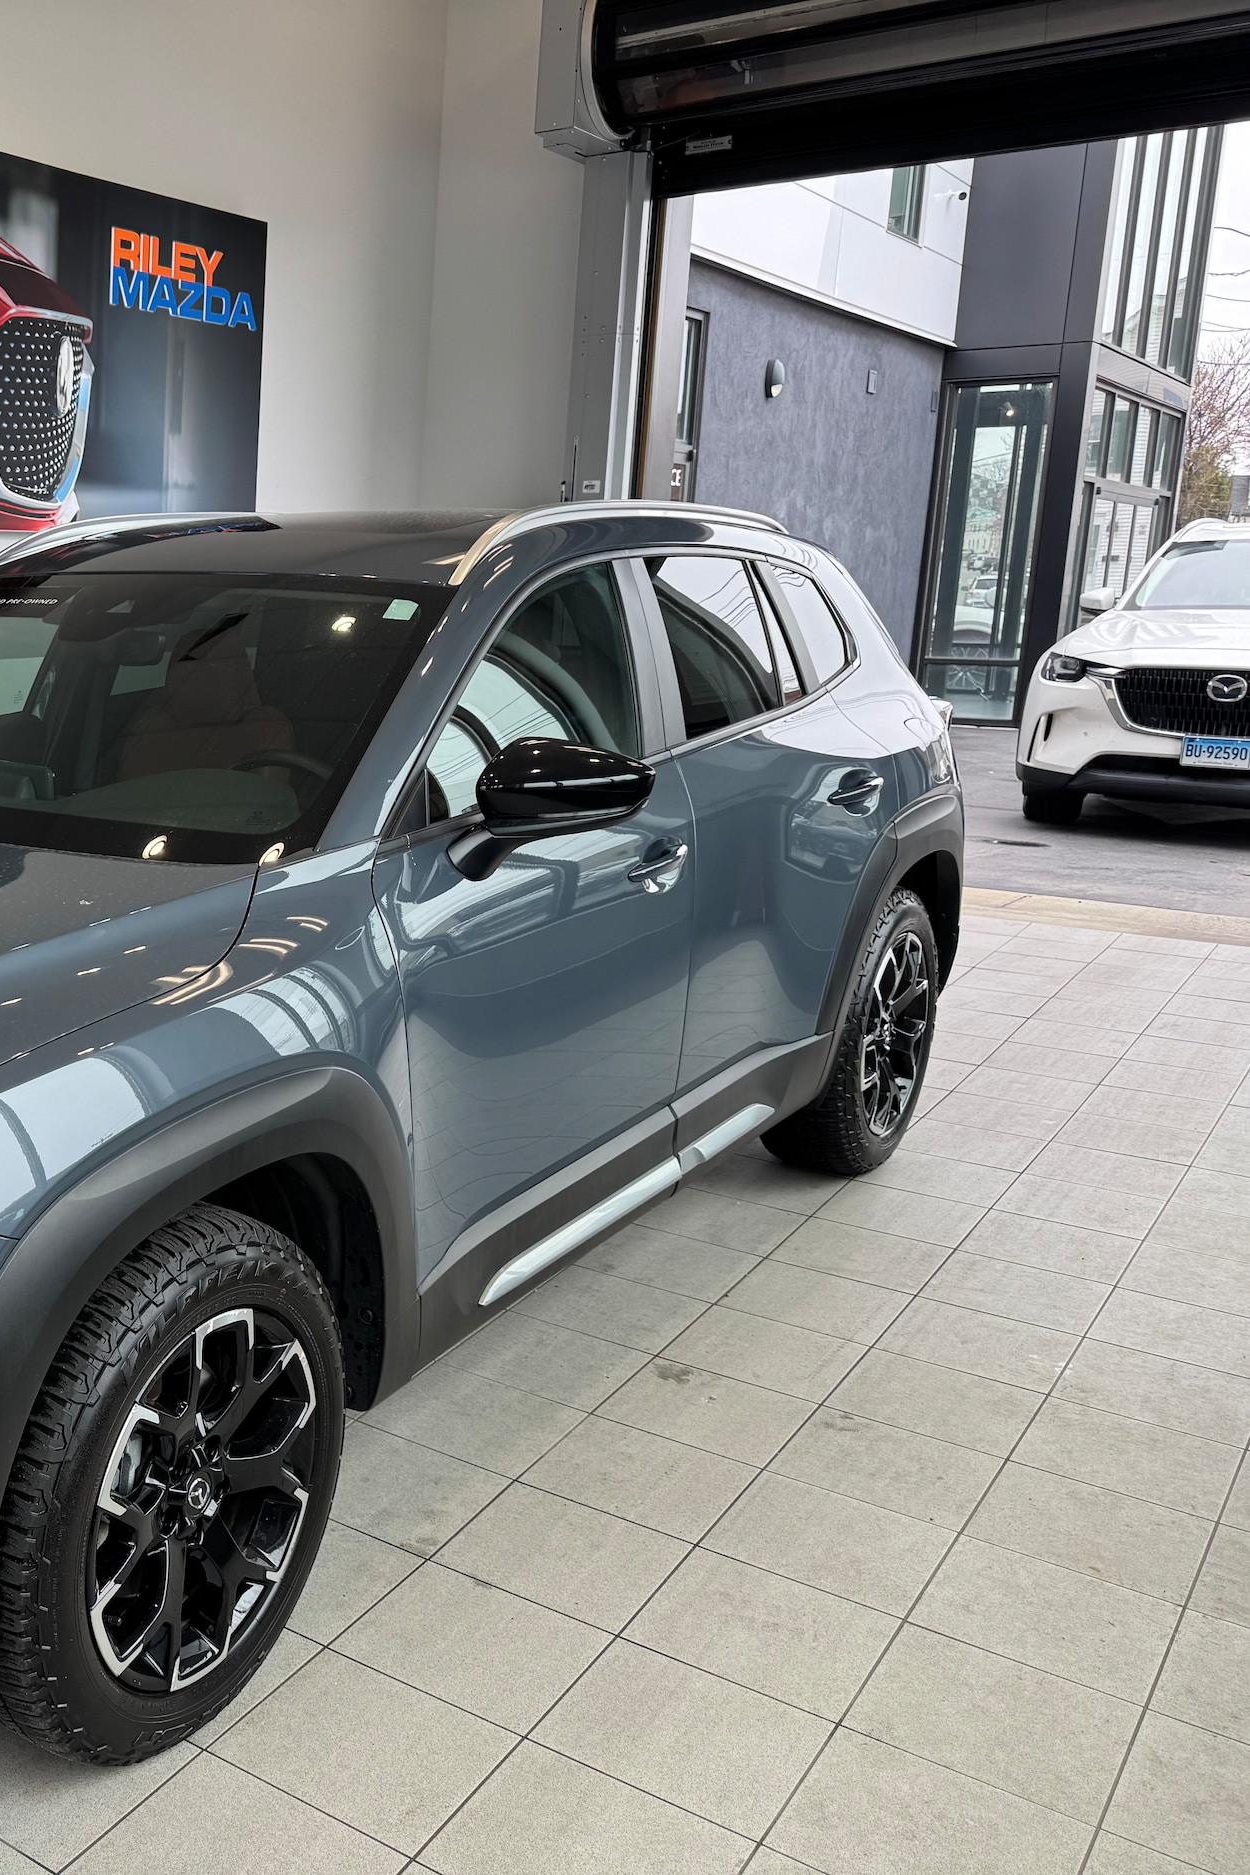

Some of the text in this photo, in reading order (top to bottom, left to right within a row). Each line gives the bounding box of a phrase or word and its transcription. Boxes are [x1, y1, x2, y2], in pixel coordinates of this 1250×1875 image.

[111, 226, 224, 287] RILEY
[109, 265, 257, 331] MAZDA
[6, 598, 58, 606] PRE-OWNED
